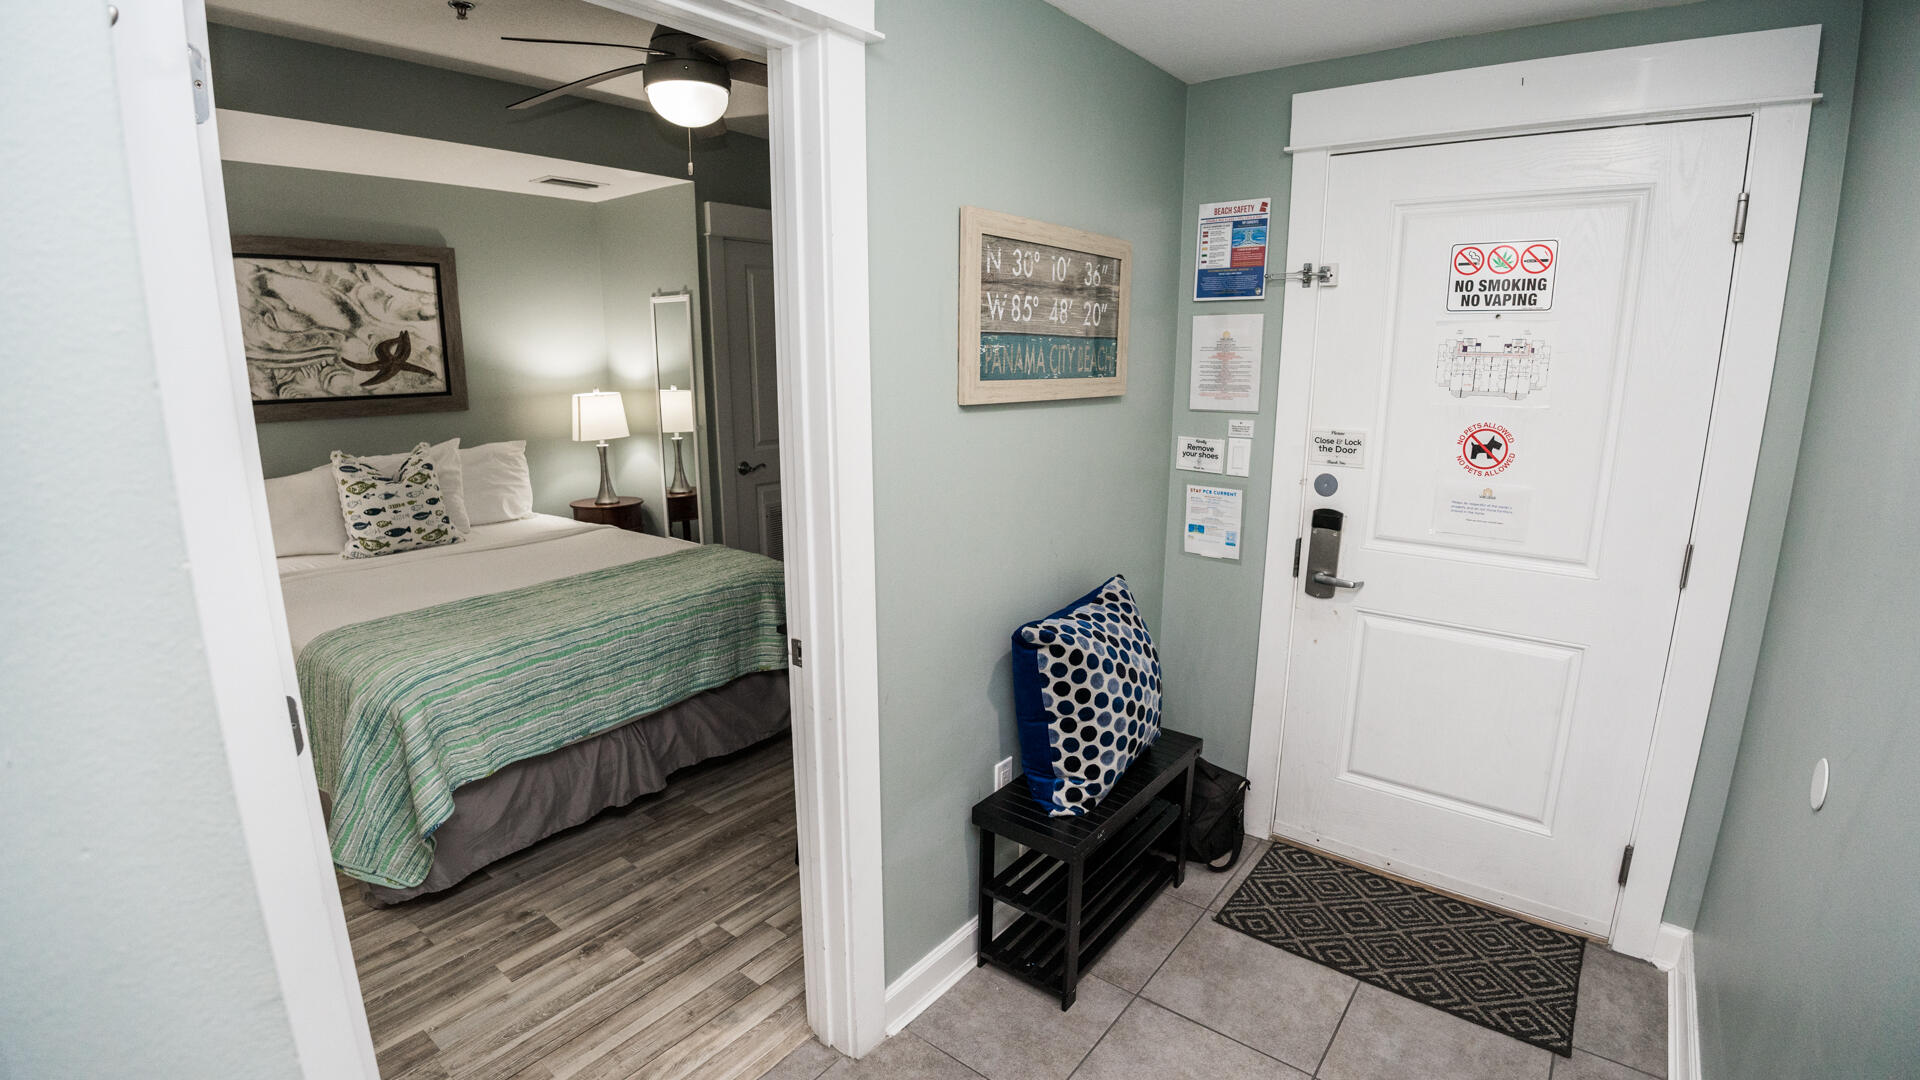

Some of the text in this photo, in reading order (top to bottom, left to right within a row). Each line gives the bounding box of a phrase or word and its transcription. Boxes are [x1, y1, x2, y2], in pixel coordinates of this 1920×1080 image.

[1214, 204, 1255, 216] BEACH SAFETY
[986, 245, 1001, 274] N
[1454, 278, 1547, 293] NO SMOKING
[986, 292, 1007, 321] W
[1460, 293, 1538, 307] NO VAPING
[985, 344, 1113, 375] PANAMA CITY BEACH
[1456, 421, 1515, 445] NO PETS ALLOWED
[1187, 443, 1214, 452] Remove
[1319, 444, 1357, 454] the Door
[1344, 438, 1362, 446] Lock
[1198, 451, 1219, 460] shoes
[1456, 452, 1516, 477] NO PETS ALLOWED
